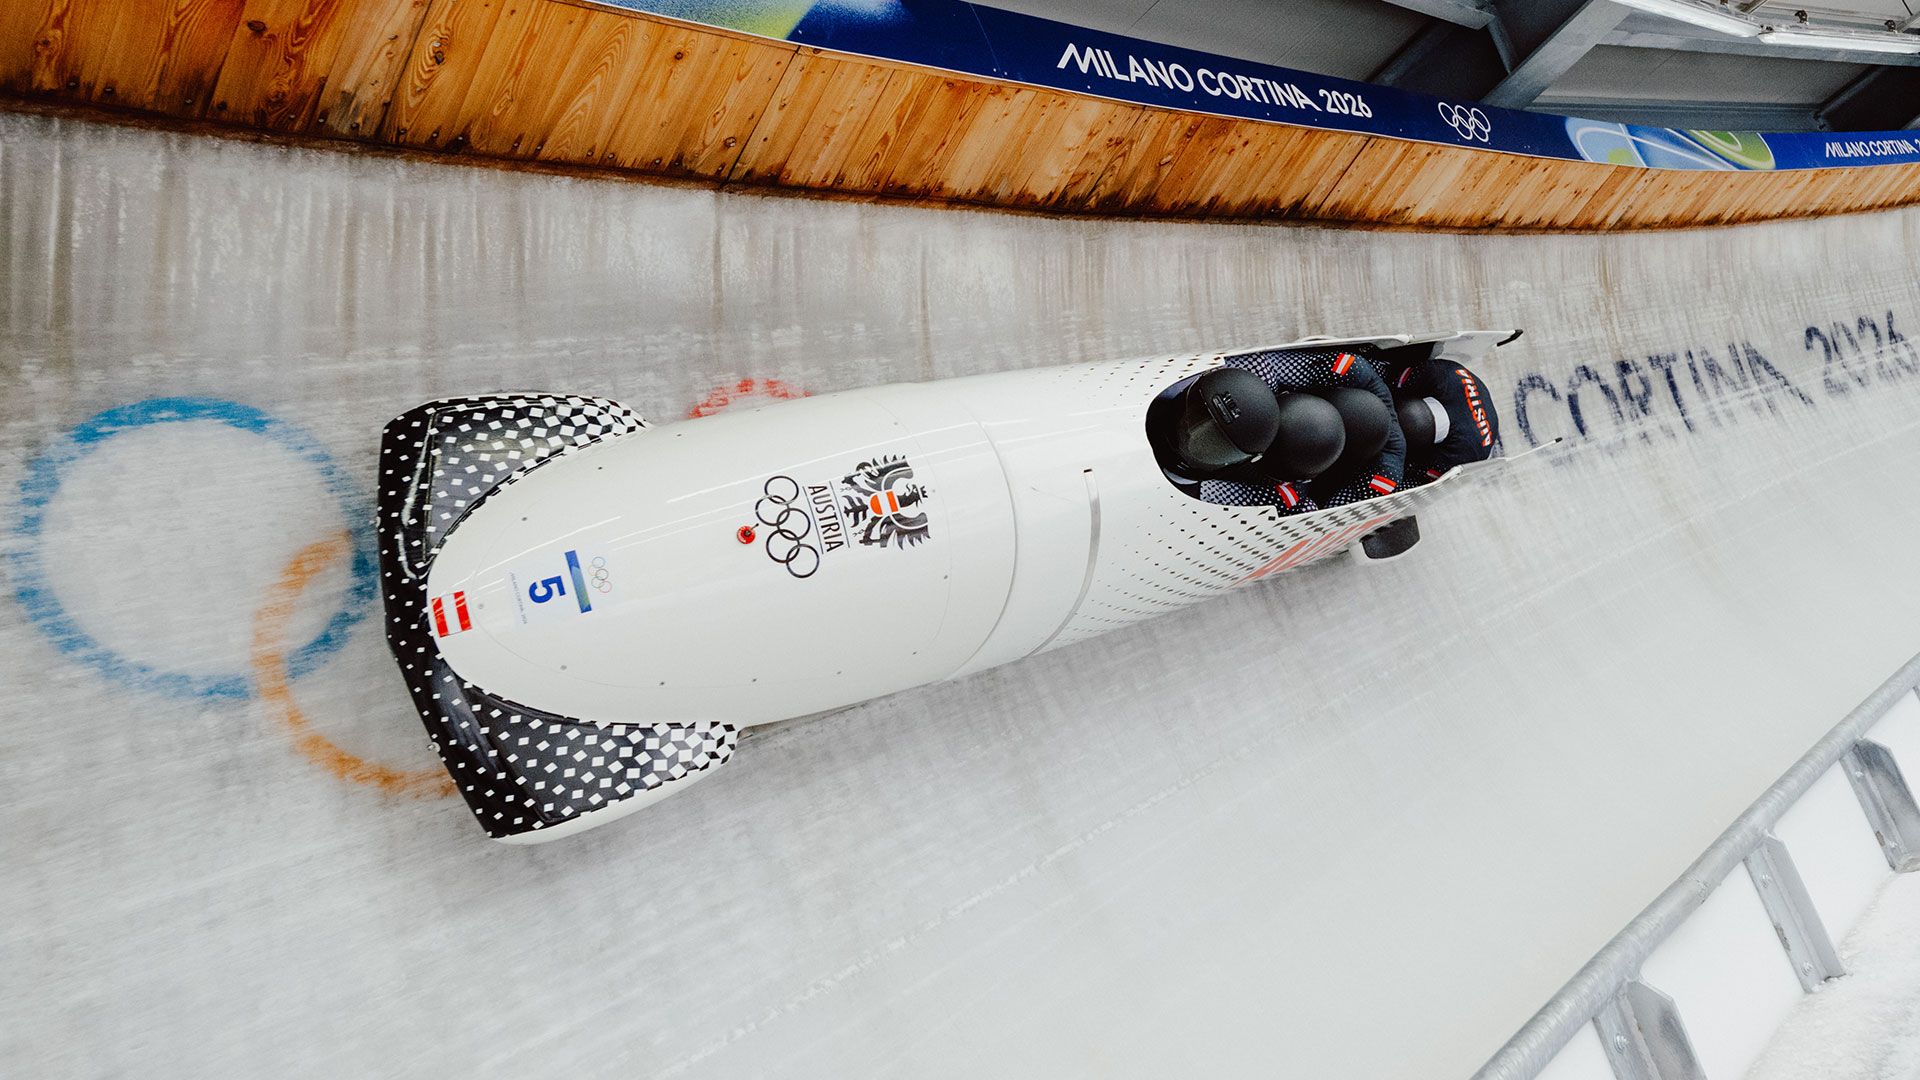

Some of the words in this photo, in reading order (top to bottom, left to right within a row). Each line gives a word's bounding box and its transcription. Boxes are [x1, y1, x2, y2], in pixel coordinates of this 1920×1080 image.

[1057, 42, 1195, 92] MILANO
[1197, 68, 1322, 112] CORTINA
[1318, 88, 1373, 118] 2026
[1825, 141, 1871, 158] MILANO
[1869, 139, 1919, 156] CORTINA
[1455, 369, 1493, 448] AUSTRIA
[1513, 340, 1815, 468] CORTINA
[1804, 308, 1919, 394] 2026
[808, 485, 845, 553] AUSTRIA
[528, 575, 567, 603] 5
